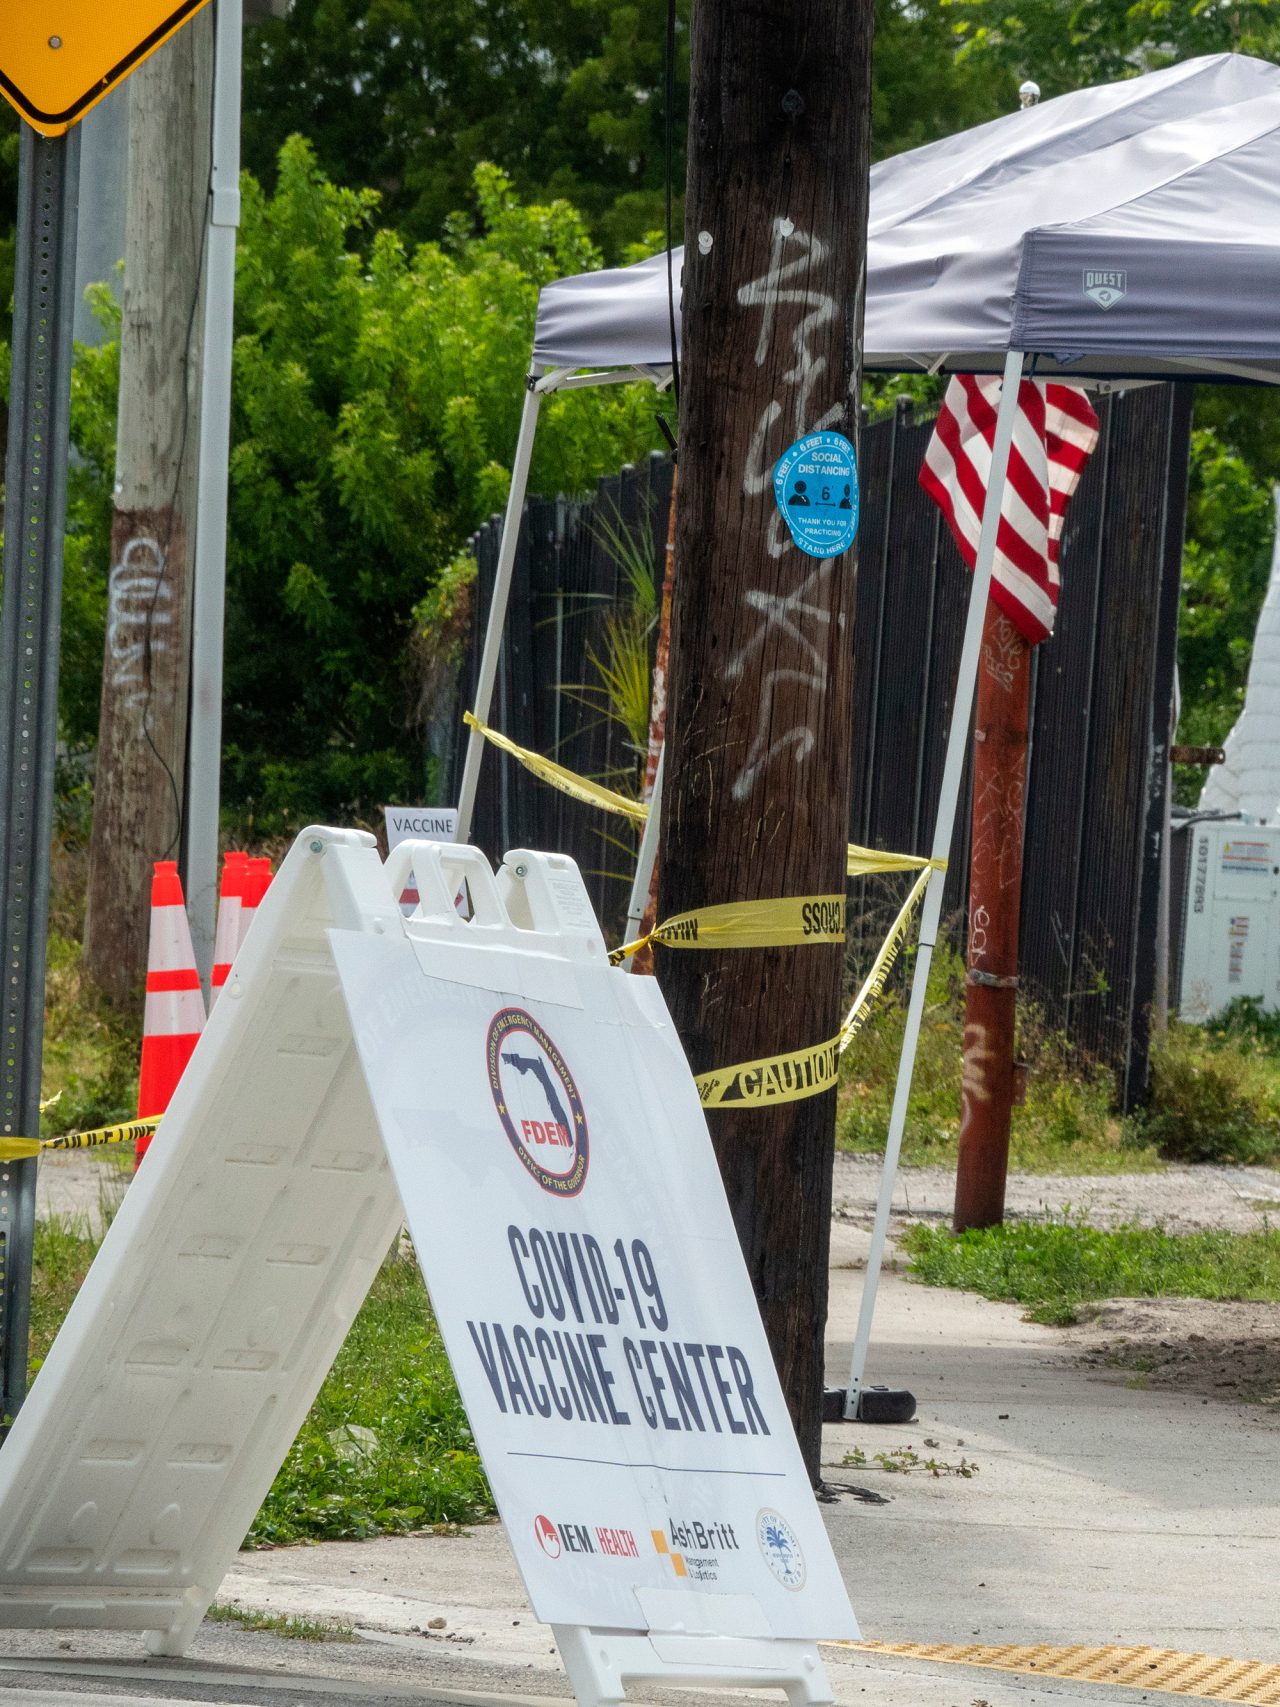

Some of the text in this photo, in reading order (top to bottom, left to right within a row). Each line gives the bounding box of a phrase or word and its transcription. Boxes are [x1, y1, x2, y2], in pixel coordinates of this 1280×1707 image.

[1086, 272, 1122, 287] QUEST
[806, 436, 822, 448] FEET
[811, 452, 842, 463] SOCIAL
[798, 464, 850, 476] DISTANCING
[798, 517, 821, 525] THANK
[804, 527, 841, 536] PRACTICING
[393, 818, 454, 833] VACCINE
[803, 902, 839, 935] CROSS
[492, 1028, 499, 1041] OF
[490, 1038, 499, 1089] DIVISION
[533, 1027, 577, 1100] MANAGEMENT
[738, 1046, 836, 1099] CAUTION
[521, 1119, 573, 1147] FDEM
[542, 1174, 552, 1186] OF
[553, 1179, 568, 1191] THE
[507, 1224, 669, 1332] COVID-19
[466, 1320, 771, 1436] VACCINE CENTER
[595, 1527, 640, 1558] HEALTH
[669, 1518, 740, 1550] AshBritt
